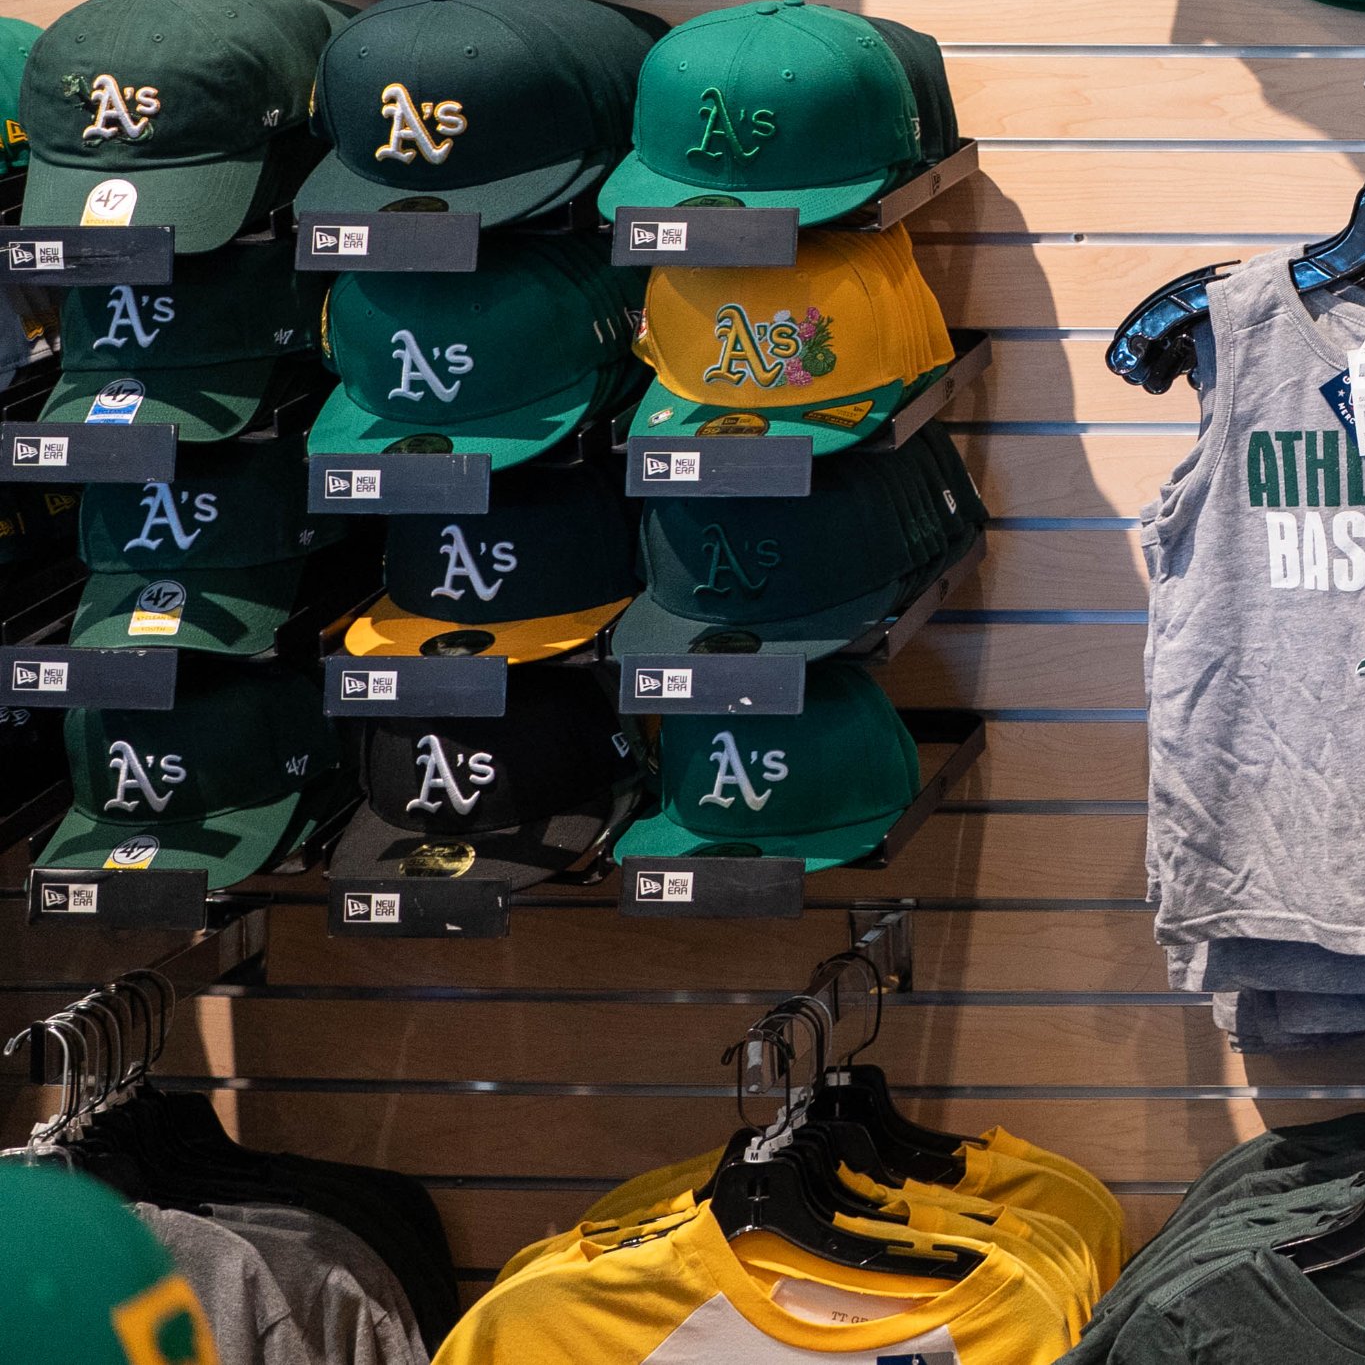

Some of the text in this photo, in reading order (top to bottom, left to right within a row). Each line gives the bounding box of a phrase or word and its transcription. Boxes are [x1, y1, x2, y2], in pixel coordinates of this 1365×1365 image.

[83, 74, 161, 139] A's
[375, 82, 468, 165] A's
[685, 87, 777, 162] A's
[343, 232, 364, 240] NEW
[661, 228, 682, 236] NEW
[343, 240, 364, 248] ERA
[661, 236, 682, 244] ERA
[40, 247, 60, 255] NEW
[40, 255, 60, 263] ERA
[93, 285, 175, 350] A's
[704, 303, 802, 389] A's
[387, 329, 474, 403] A's
[43, 443, 63, 451] NEW
[43, 451, 63, 459] ERA
[674, 458, 695, 466] NEW
[674, 466, 695, 474] ERA
[356, 476, 376, 484] NEW
[356, 484, 376, 492] ERA
[123, 482, 218, 552] A's
[430, 524, 518, 601] A's
[693, 523, 782, 594] A's
[43, 668, 63, 676] NEW
[43, 676, 63, 684] ERA
[372, 677, 392, 685] NEW
[667, 675, 687, 683] NEW
[372, 685, 392, 693] ERA
[667, 683, 687, 691] ERA
[406, 734, 496, 815] A's
[699, 731, 789, 811] A's
[104, 740, 187, 813] A's
[668, 878, 688, 886] NEW
[73, 890, 93, 898] NEW
[668, 886, 688, 894] ERA
[73, 898, 93, 906] ERA
[375, 899, 395, 907] NEW
[375, 907, 395, 915] ERA
[750, 1152, 759, 1161] M
